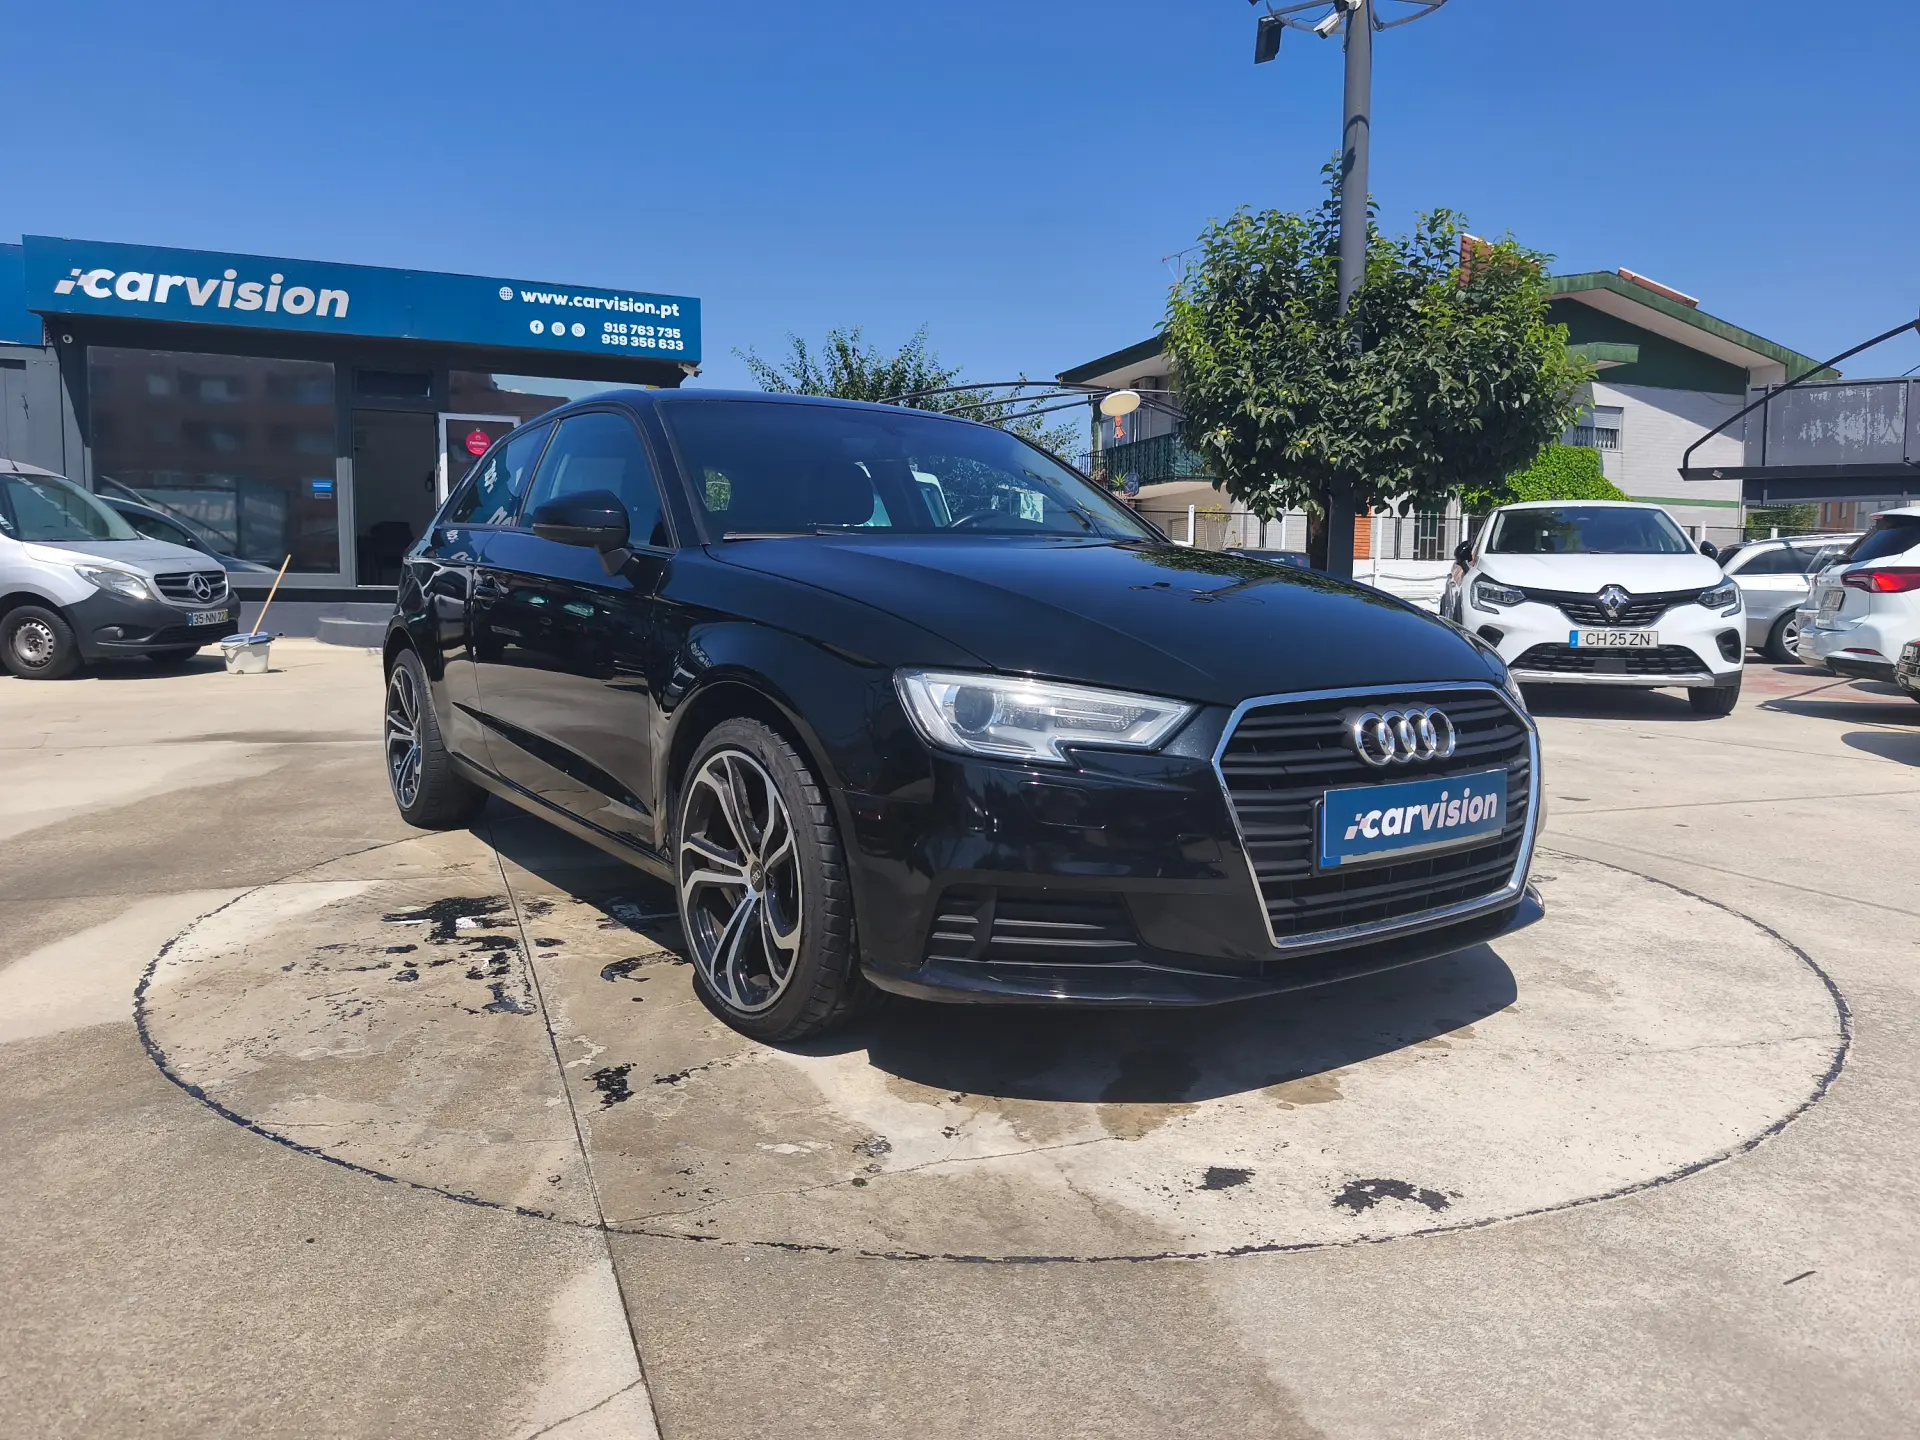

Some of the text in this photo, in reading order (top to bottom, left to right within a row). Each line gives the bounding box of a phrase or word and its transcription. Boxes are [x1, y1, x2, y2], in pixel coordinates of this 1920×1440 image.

[81, 268, 350, 318] carvision
[520, 289, 680, 318] www.carvision.pt
[601, 333, 684, 351] 939 356 633
[603, 322, 681, 339] 916 763 735
[1585, 633, 1650, 646] CH 25 ZN
[1361, 788, 1498, 838] carvision
